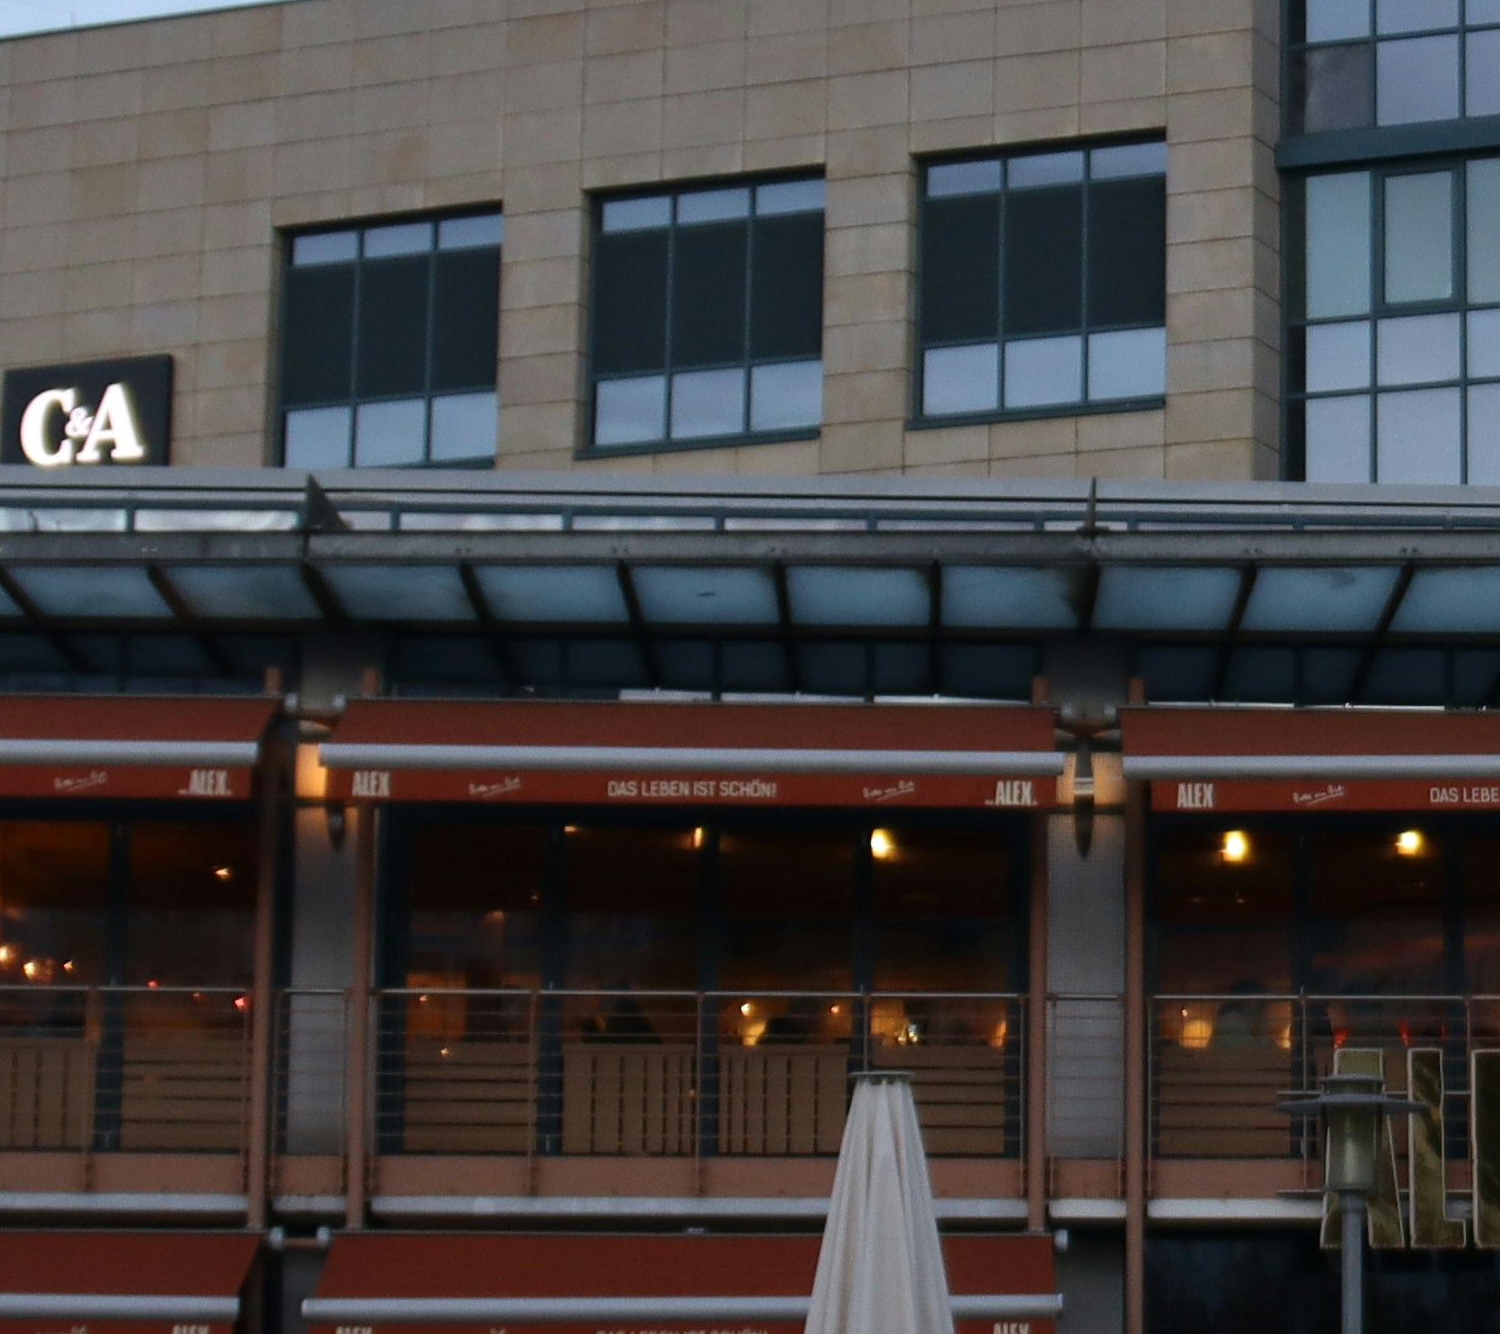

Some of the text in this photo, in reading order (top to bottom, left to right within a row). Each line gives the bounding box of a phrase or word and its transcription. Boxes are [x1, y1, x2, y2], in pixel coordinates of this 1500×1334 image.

[19, 381, 146, 467] C&A
[352, 771, 390, 797] ALEX
[607, 777, 777, 797] DAS LEBEN IST SCHÖN!
[1177, 783, 1213, 808] ALEX
[1429, 787, 1459, 803] DAS
